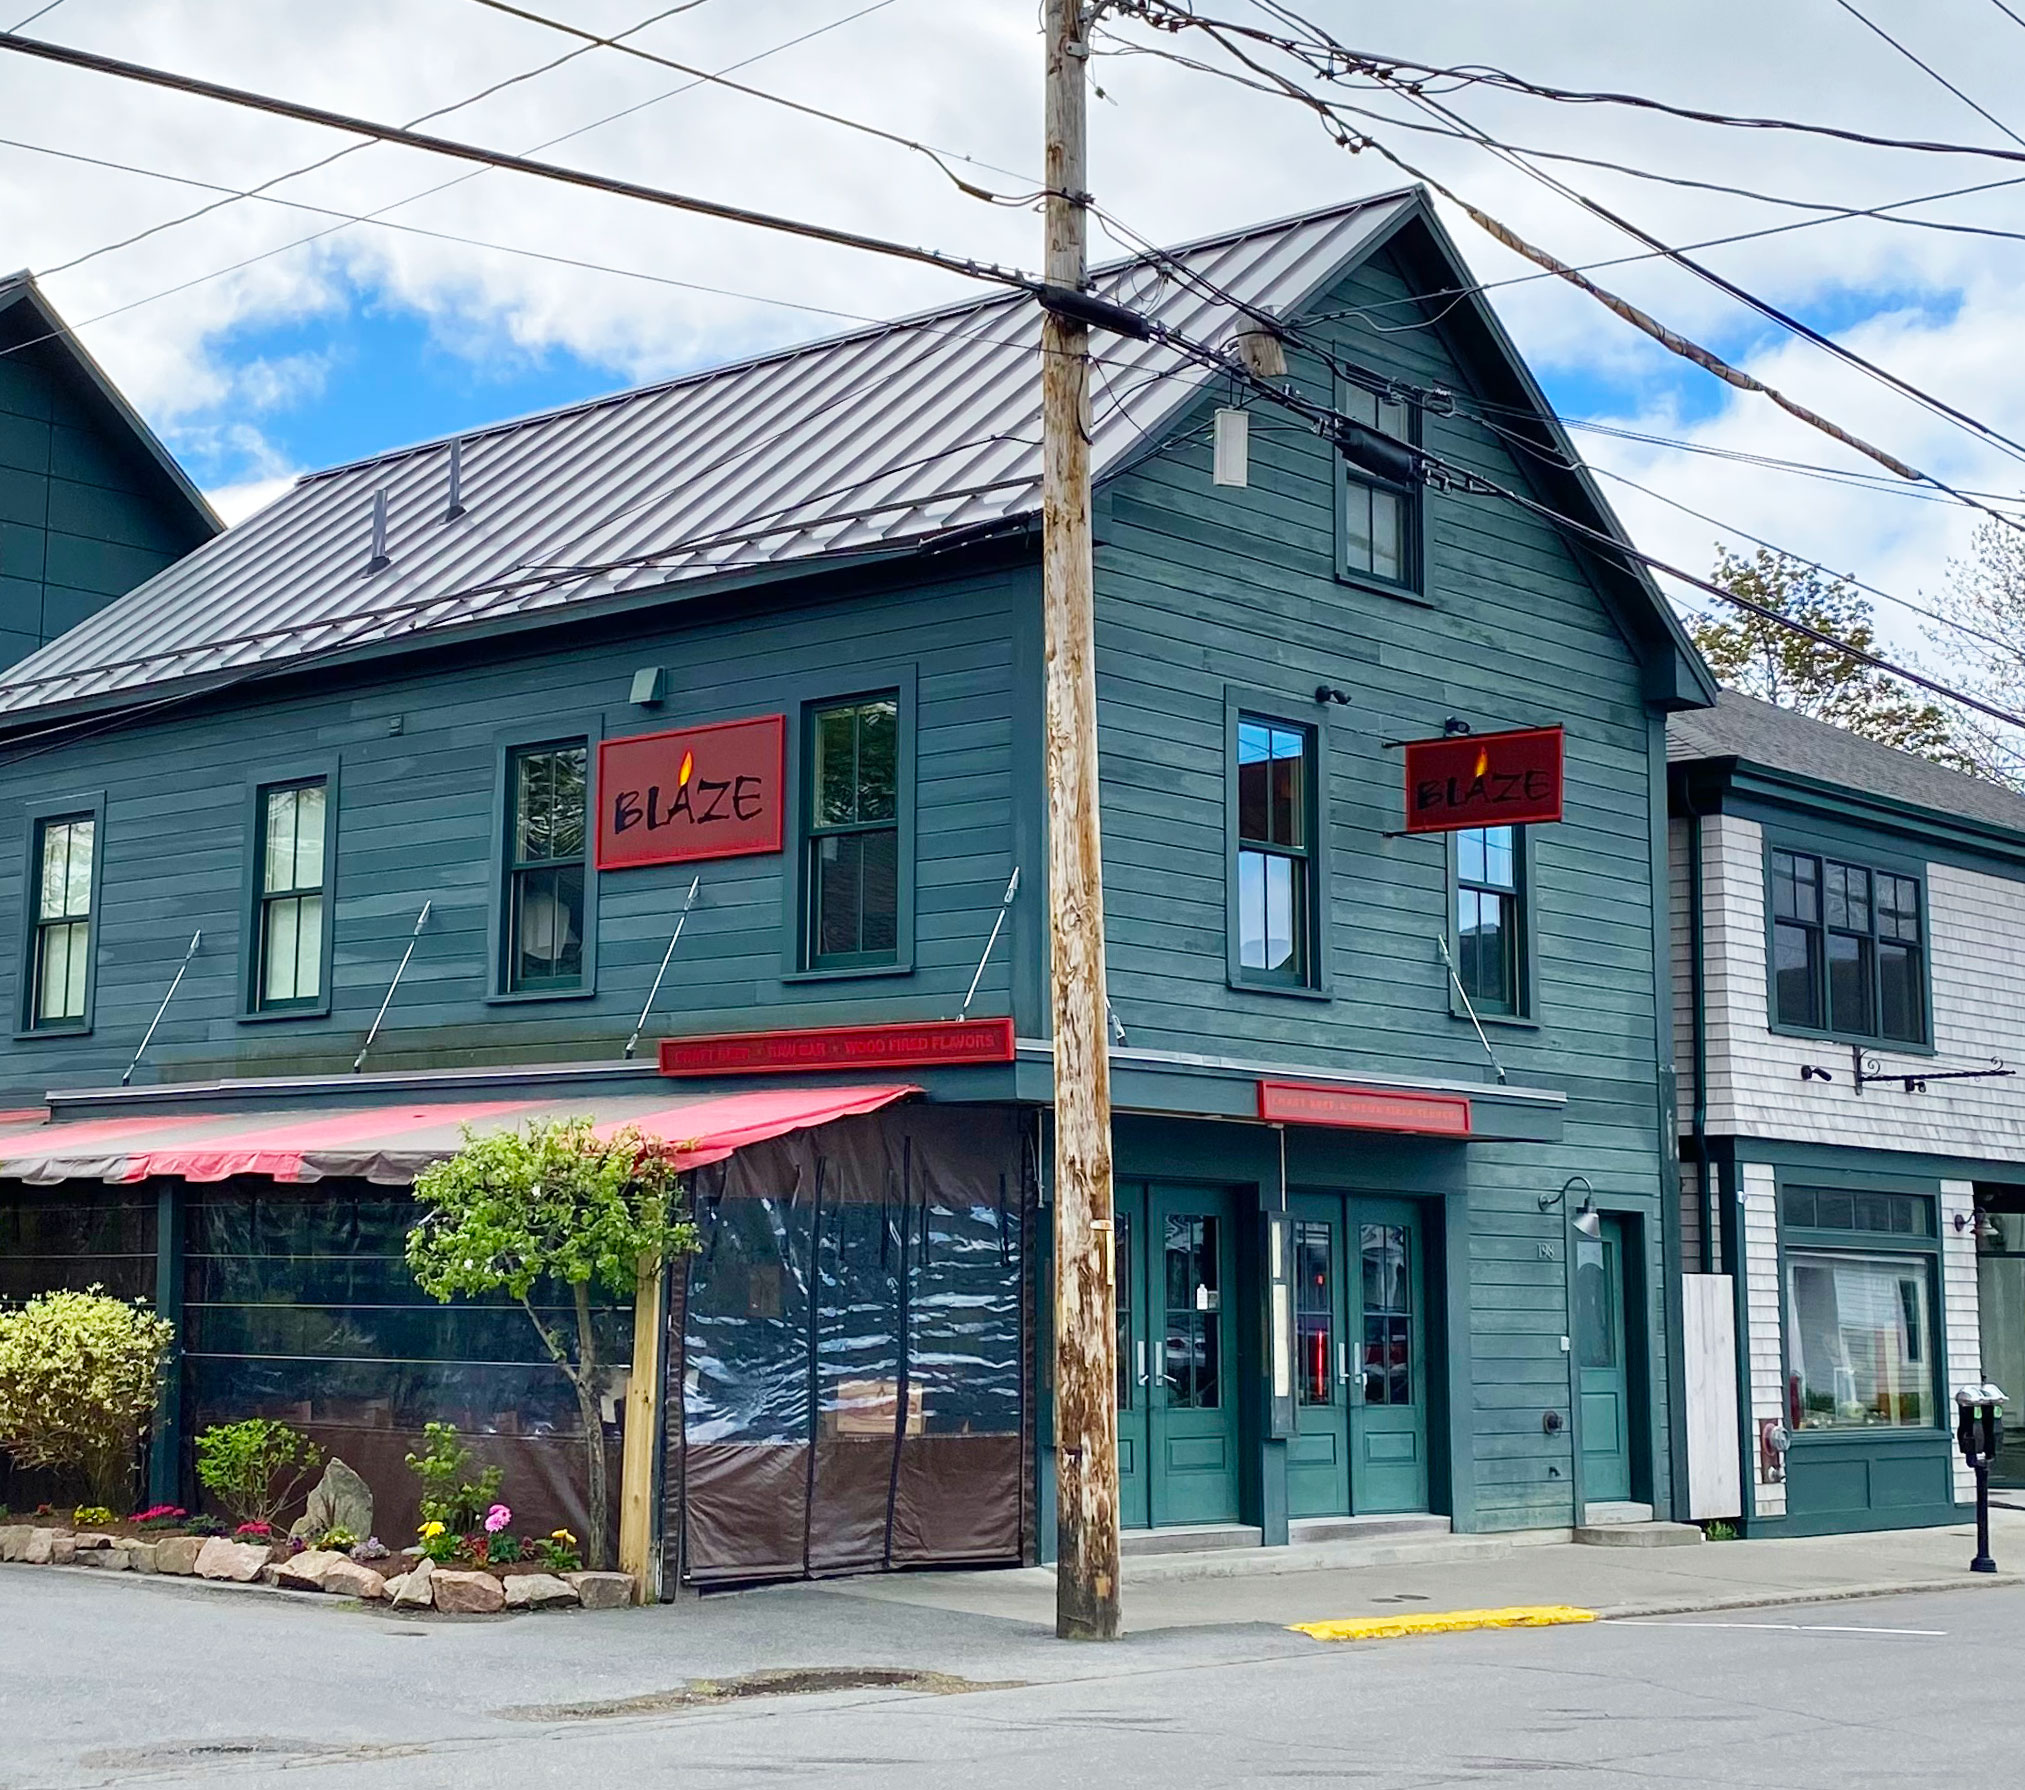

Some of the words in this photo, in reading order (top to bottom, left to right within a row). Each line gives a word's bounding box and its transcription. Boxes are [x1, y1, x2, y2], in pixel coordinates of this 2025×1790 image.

[615, 775, 763, 834] BLAZE
[1416, 769, 1551, 810] BLAZE
[844, 1038, 886, 1054] WOOD
[931, 1034, 995, 1050] FLAVORS
[1537, 1242, 1555, 1260] 198
